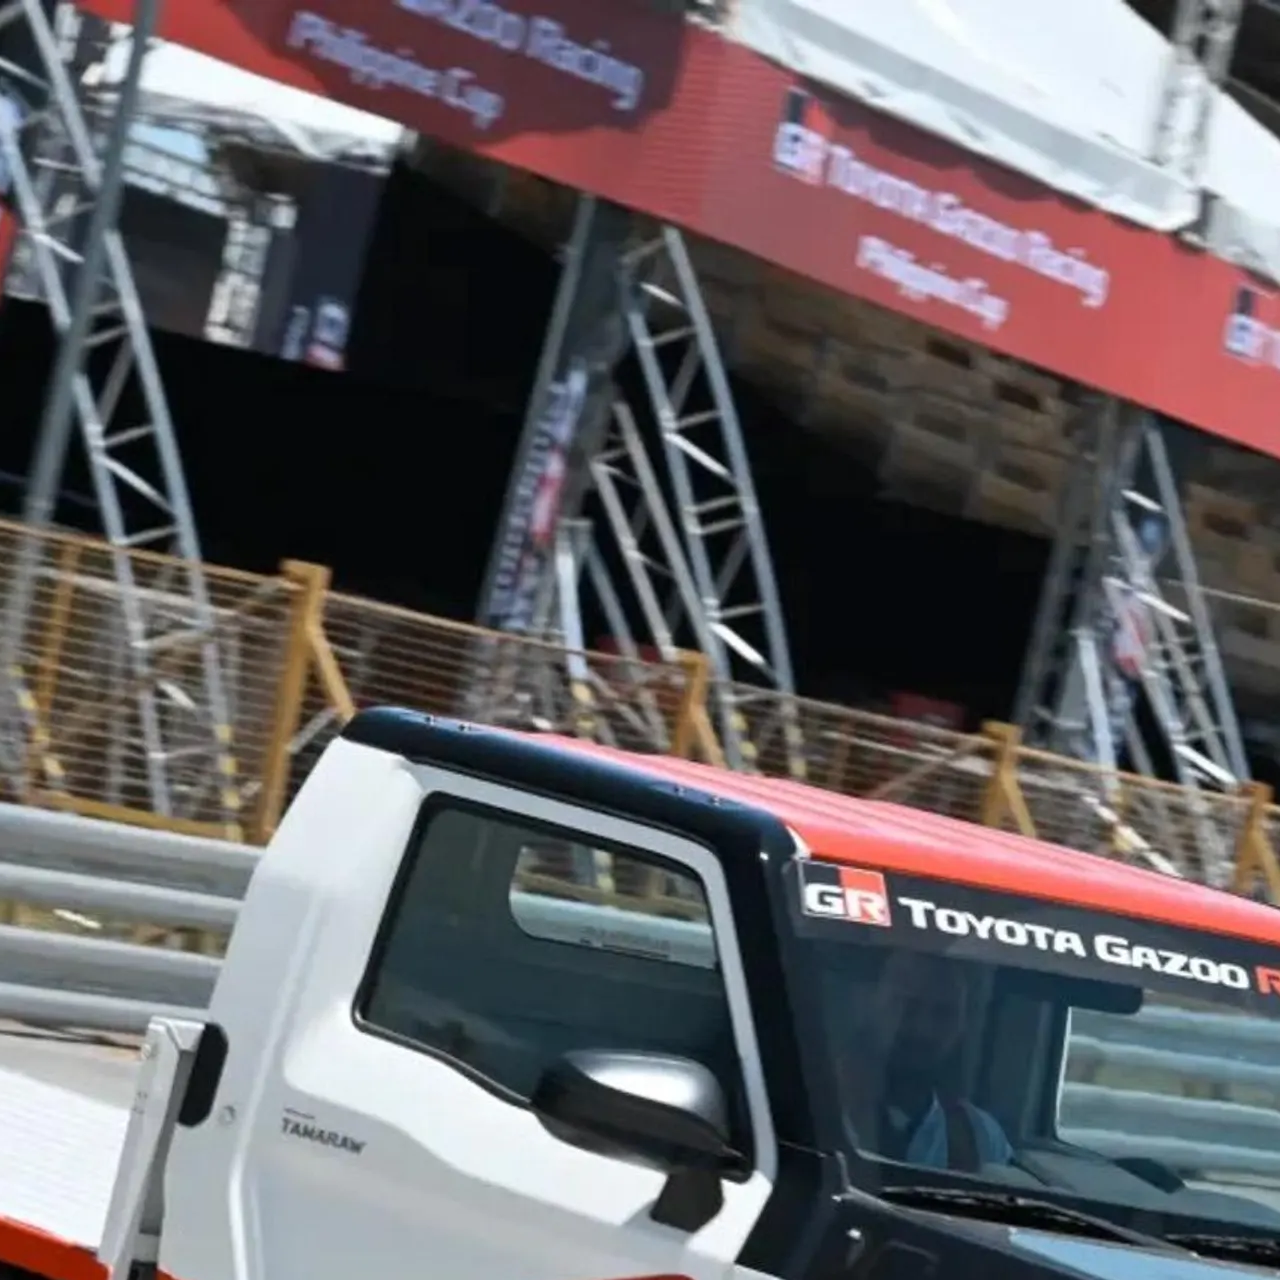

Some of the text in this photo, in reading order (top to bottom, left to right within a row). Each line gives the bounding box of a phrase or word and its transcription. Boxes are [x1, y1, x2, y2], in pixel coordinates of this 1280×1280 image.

[804, 882, 888, 925] GR
[897, 896, 1086, 957] TOYOTA
[1093, 934, 1250, 989] GAZOO
[282, 1117, 367, 1154] TAMARAW
